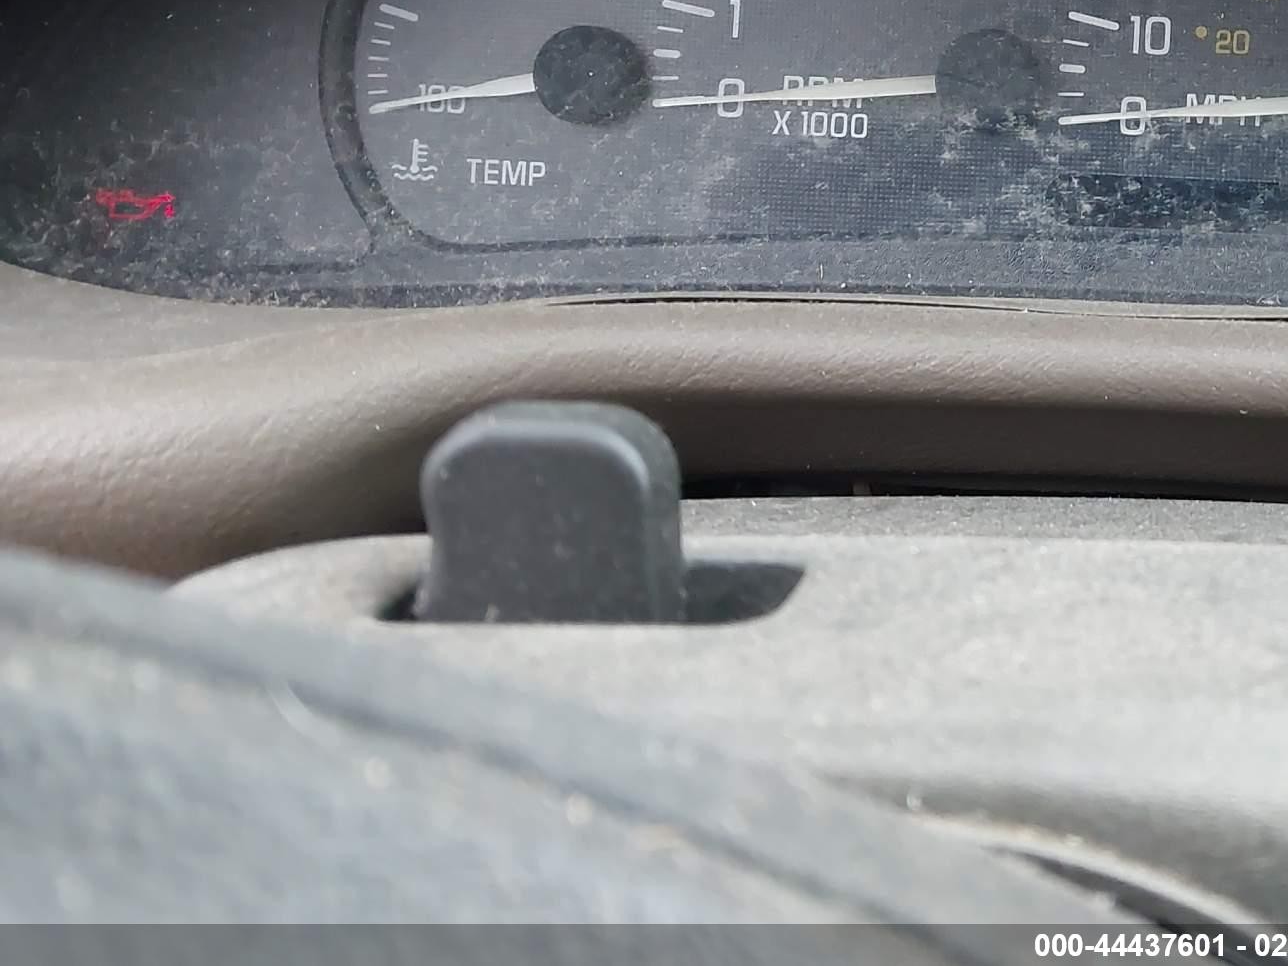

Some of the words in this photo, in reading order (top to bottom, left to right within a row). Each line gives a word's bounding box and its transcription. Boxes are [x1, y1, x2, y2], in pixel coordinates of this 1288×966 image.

[729, 0, 741, 38] 1
[1130, 16, 1171, 55] 10
[1215, 31, 1250, 54] 20
[718, 79, 745, 117] 0
[1120, 97, 1147, 135] 0
[772, 111, 791, 135] X
[802, 111, 868, 139] 1000
[467, 159, 546, 186] TEMP
